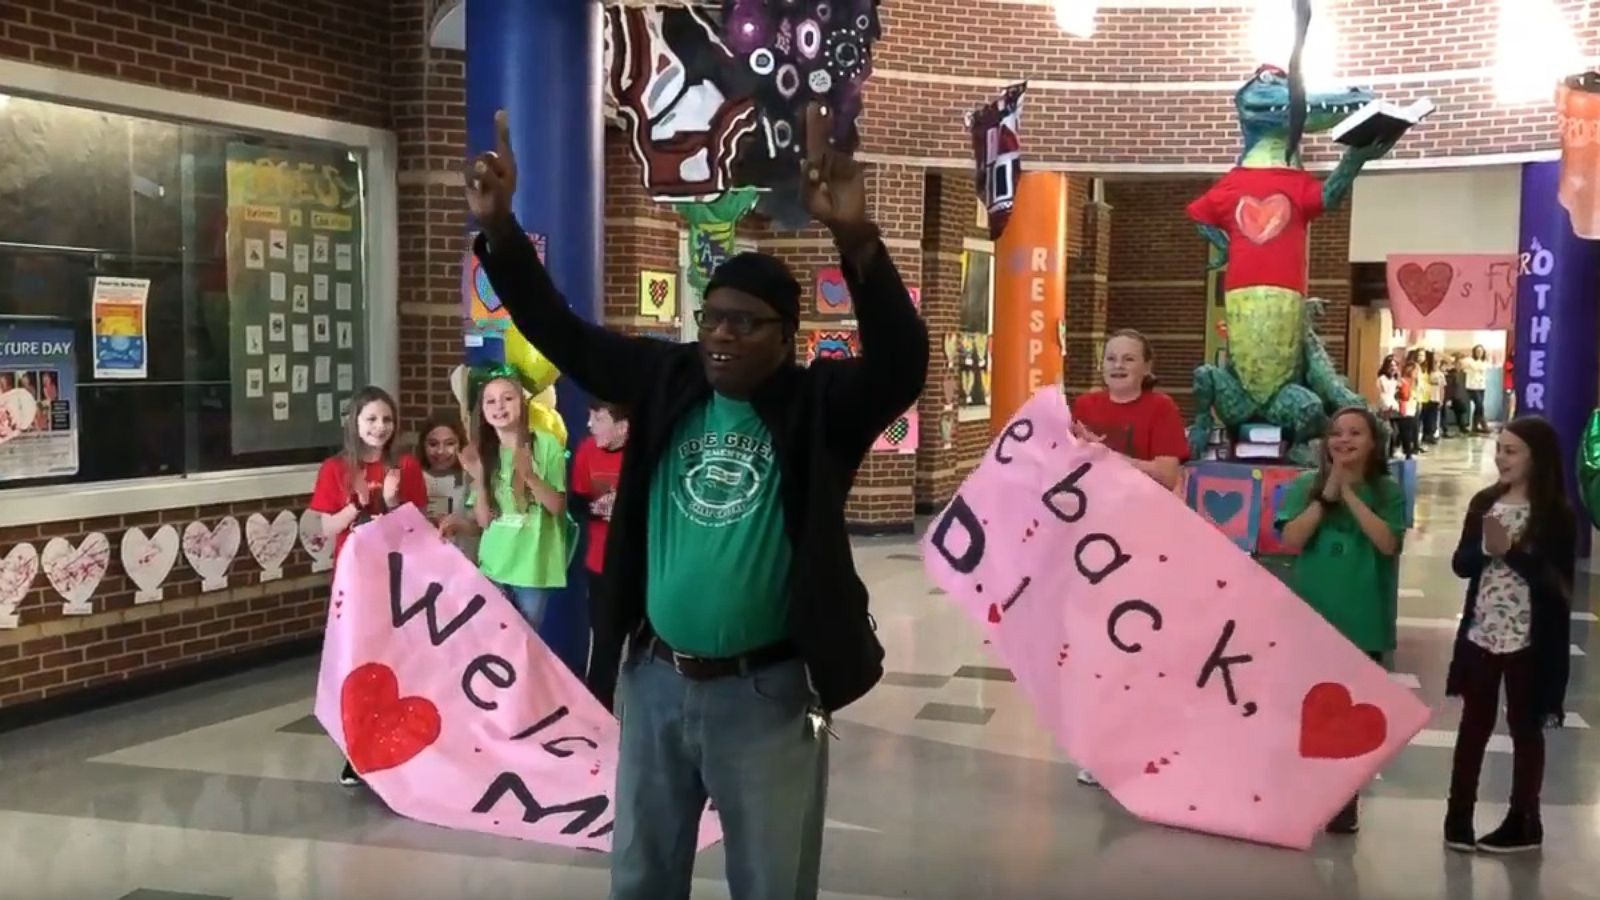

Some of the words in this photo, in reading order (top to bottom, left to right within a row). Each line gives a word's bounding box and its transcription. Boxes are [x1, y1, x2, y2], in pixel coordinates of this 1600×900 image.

[41, 341, 72, 355] DAY
[1028, 247, 1048, 393] RESPE
[388, 551, 598, 758] Welc
[1041, 461, 1258, 717] back,
[471, 771, 614, 839] M
